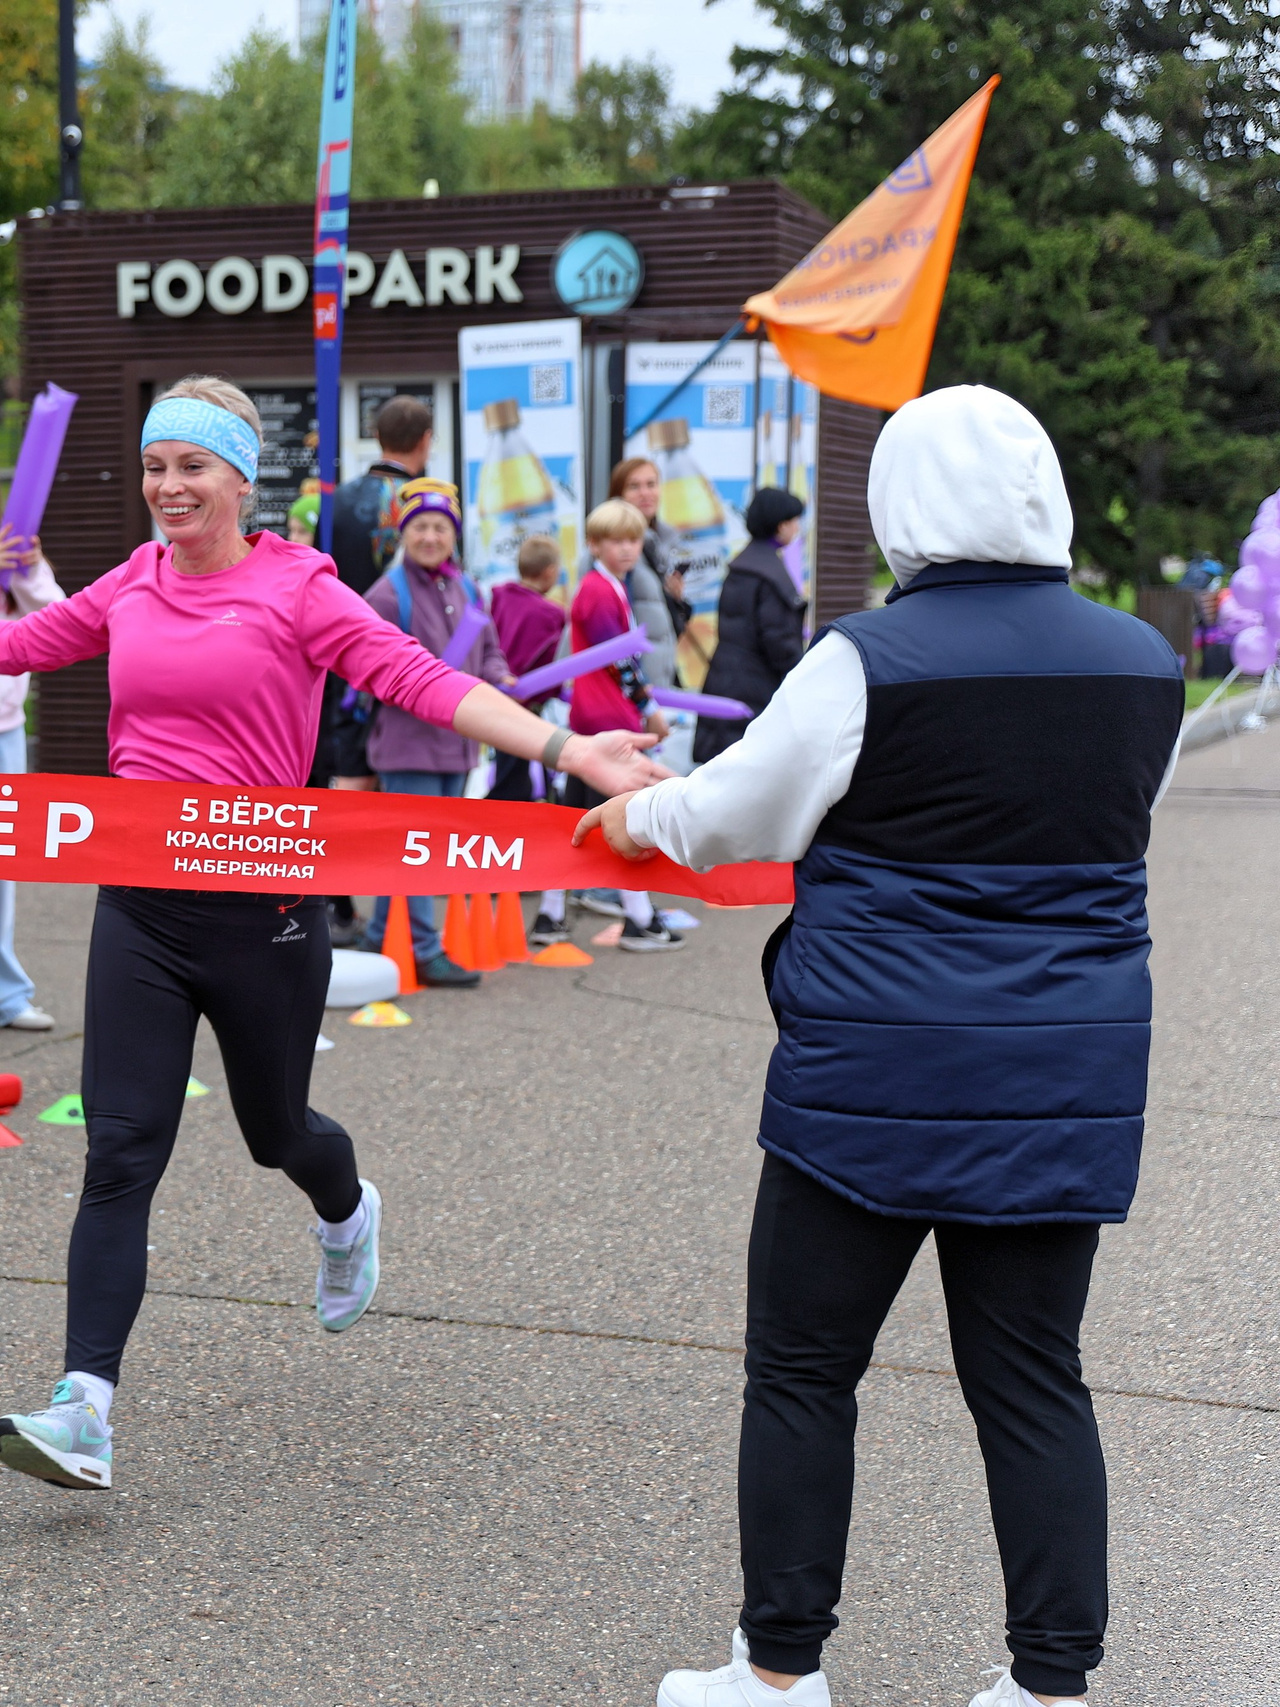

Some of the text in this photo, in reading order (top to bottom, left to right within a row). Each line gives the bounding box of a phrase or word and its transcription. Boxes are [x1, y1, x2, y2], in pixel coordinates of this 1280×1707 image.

[117, 244, 523, 318] FOOD PARK
[179, 795, 318, 829] 5 ВЁРСТ
[165, 830, 327, 857] КРАСНОЯРСК
[401, 830, 525, 871] 5 КМ
[173, 857, 315, 880] НАБЕРЕЖНАЯ
[271, 932, 308, 943] DEMIX
